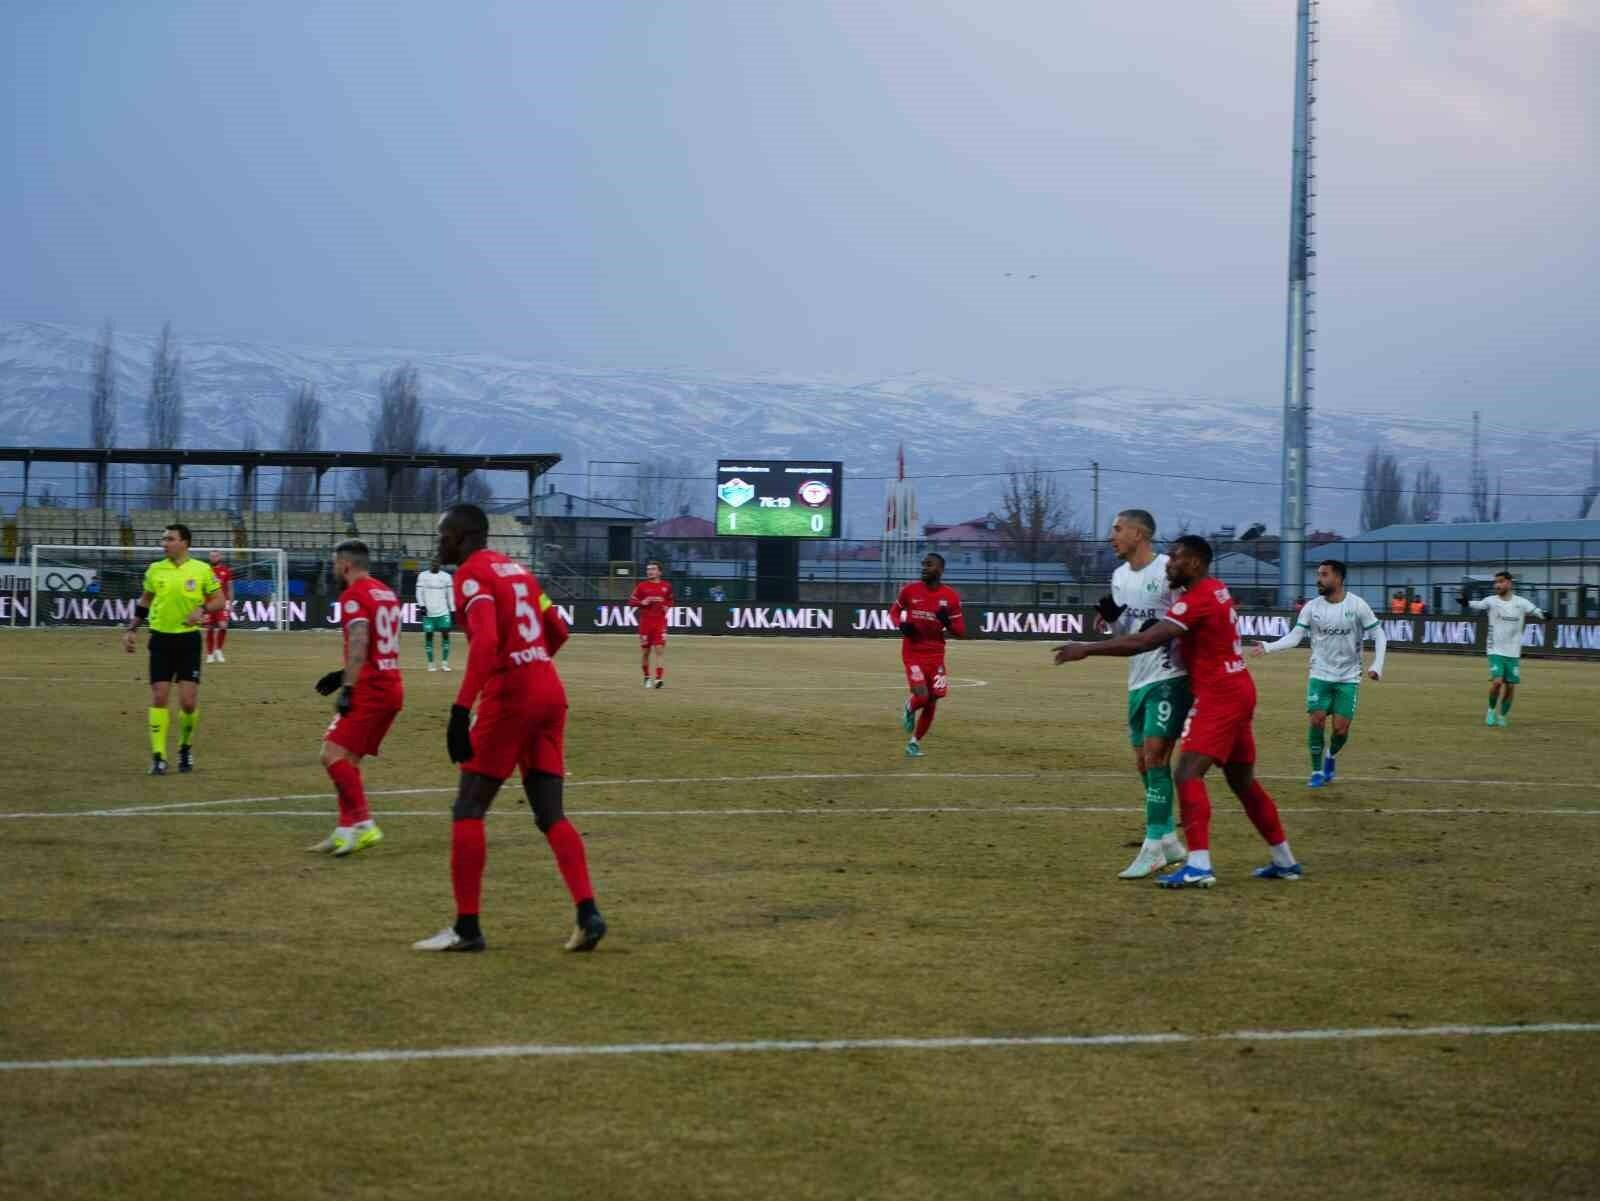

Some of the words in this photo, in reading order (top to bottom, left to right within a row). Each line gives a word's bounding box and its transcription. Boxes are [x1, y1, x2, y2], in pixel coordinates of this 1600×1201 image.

[728, 513, 737, 530] 1
[811, 514, 824, 531] 0
[50, 598, 136, 619] JAKAM
[227, 600, 306, 622] KAMEN
[594, 606, 702, 627] JAKEN
[726, 607, 833, 629] JAKAMEN
[980, 611, 1083, 634] JAKAMEN
[512, 583, 541, 642] 5
[375, 605, 400, 654] 92
[1238, 616, 1292, 637] AKAMEN
[1157, 701, 1172, 722] 9
